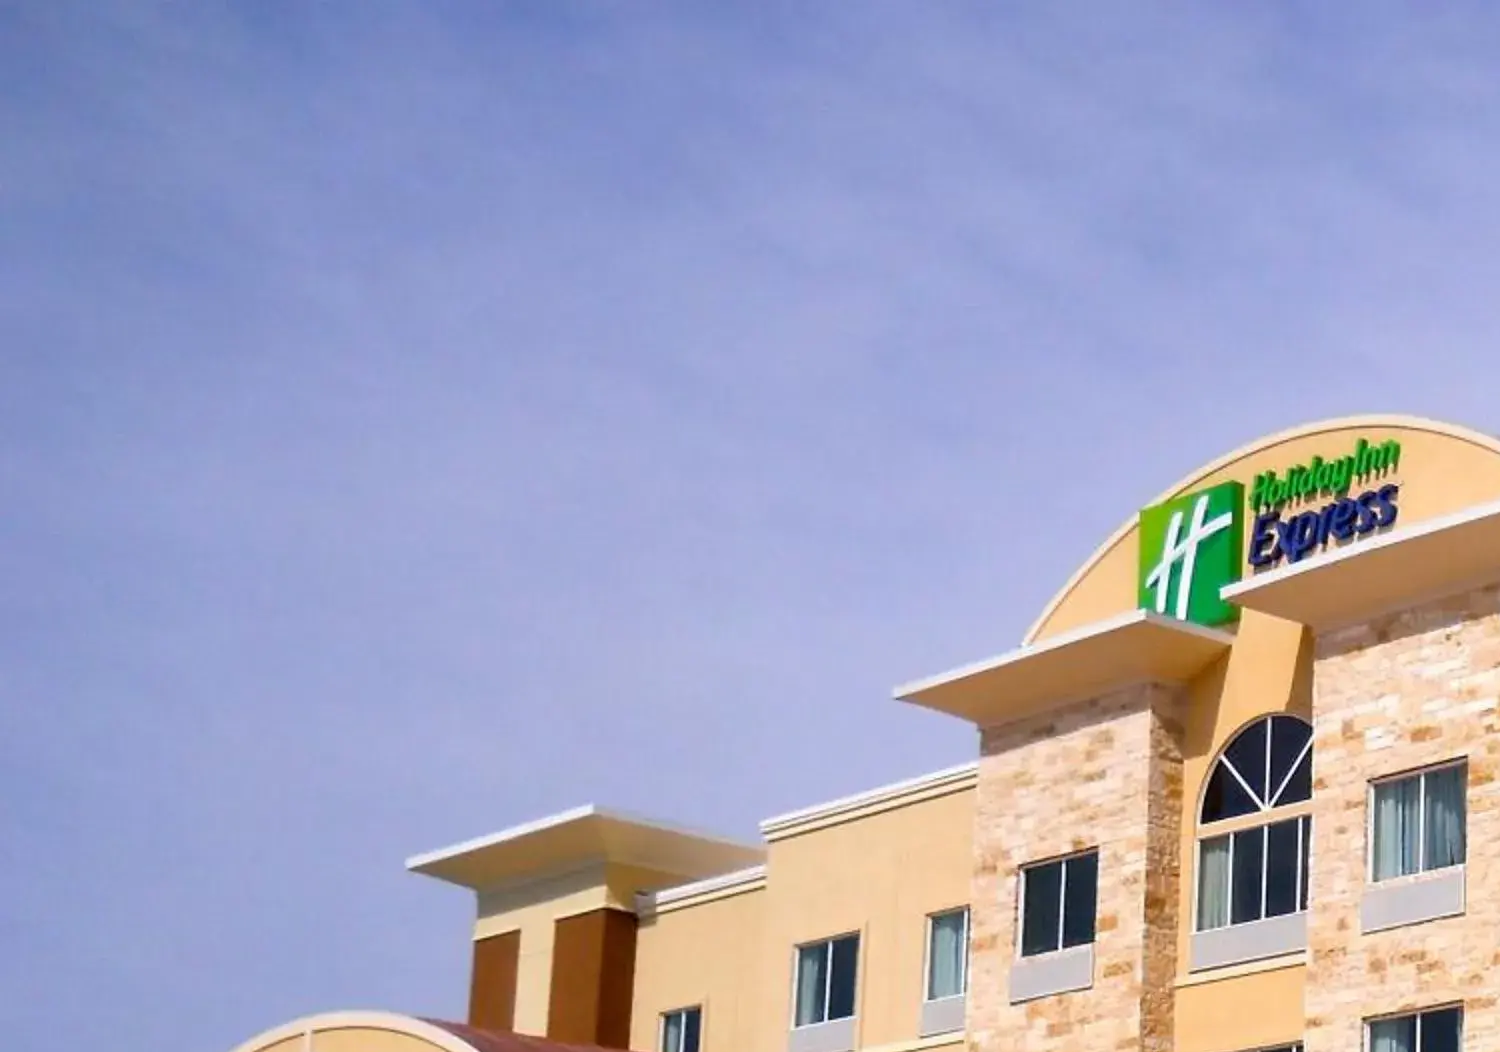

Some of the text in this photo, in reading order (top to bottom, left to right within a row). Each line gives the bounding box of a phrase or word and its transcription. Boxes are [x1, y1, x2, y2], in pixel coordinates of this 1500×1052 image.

[1251, 438, 1401, 512] Holiday Inn
[1248, 484, 1399, 567] Express
